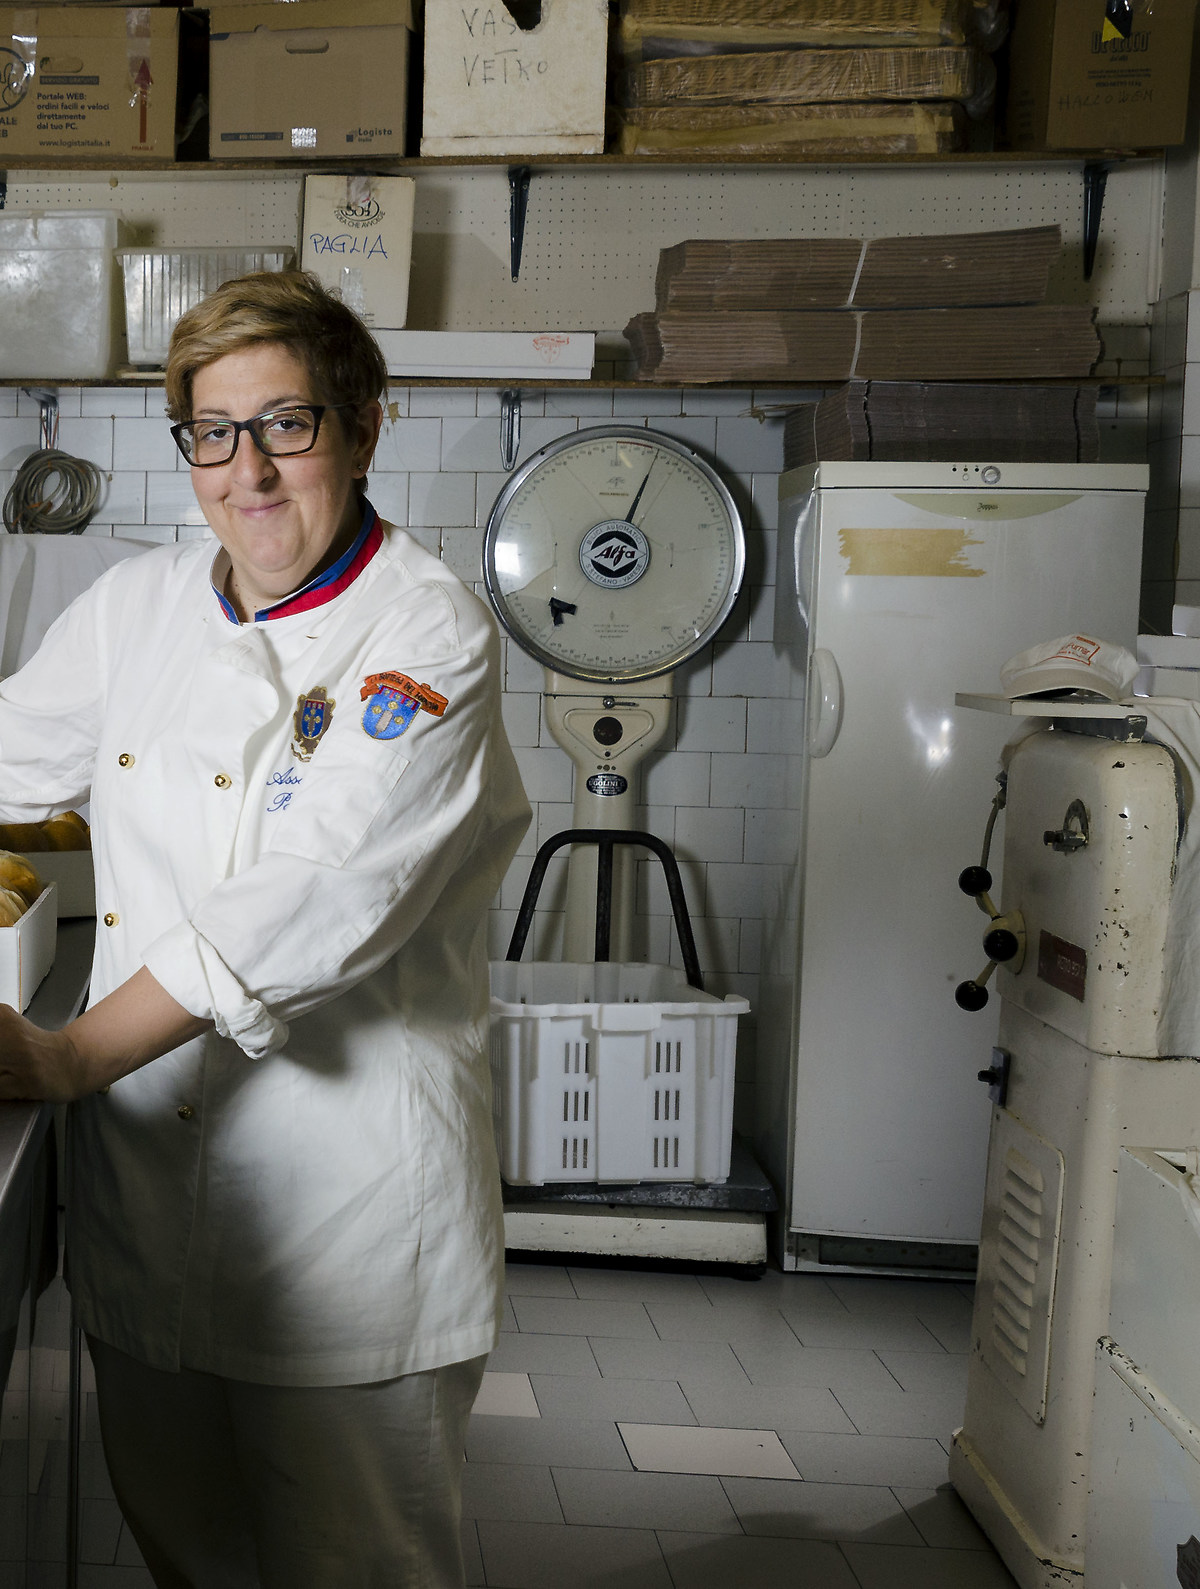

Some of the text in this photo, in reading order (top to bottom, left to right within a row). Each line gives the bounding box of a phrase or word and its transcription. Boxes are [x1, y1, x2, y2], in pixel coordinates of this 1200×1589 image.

[37, 92, 87, 100] Portale WEB:
[37, 102, 59, 110] ordini
[61, 102, 79, 110] facili
[87, 102, 110, 111] veloci
[37, 112, 86, 120] direttamente
[37, 122, 49, 130] dal
[65, 122, 78, 130] PC.
[39, 139, 111, 148] www.logistaitalia.it
[309, 233, 388, 259] PAGLIA
[594, 544, 636, 567] Alfa
[623, 564, 642, 582] VARESE
